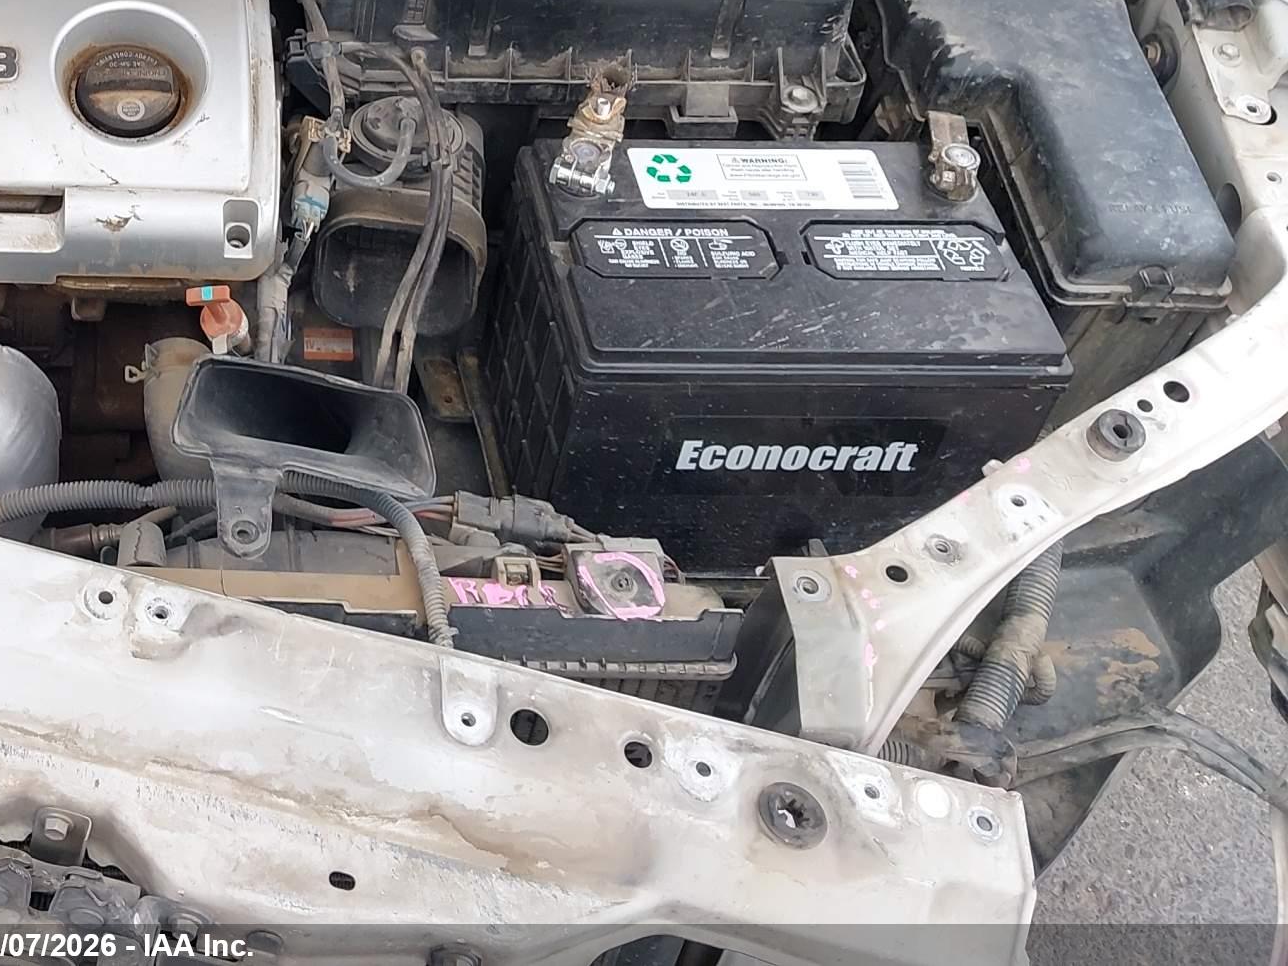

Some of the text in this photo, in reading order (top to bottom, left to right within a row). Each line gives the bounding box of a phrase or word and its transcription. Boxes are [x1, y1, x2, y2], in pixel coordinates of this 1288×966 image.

[623, 228, 673, 236] DANGER
[684, 228, 729, 237] POISON
[675, 439, 919, 472] Econocraft
